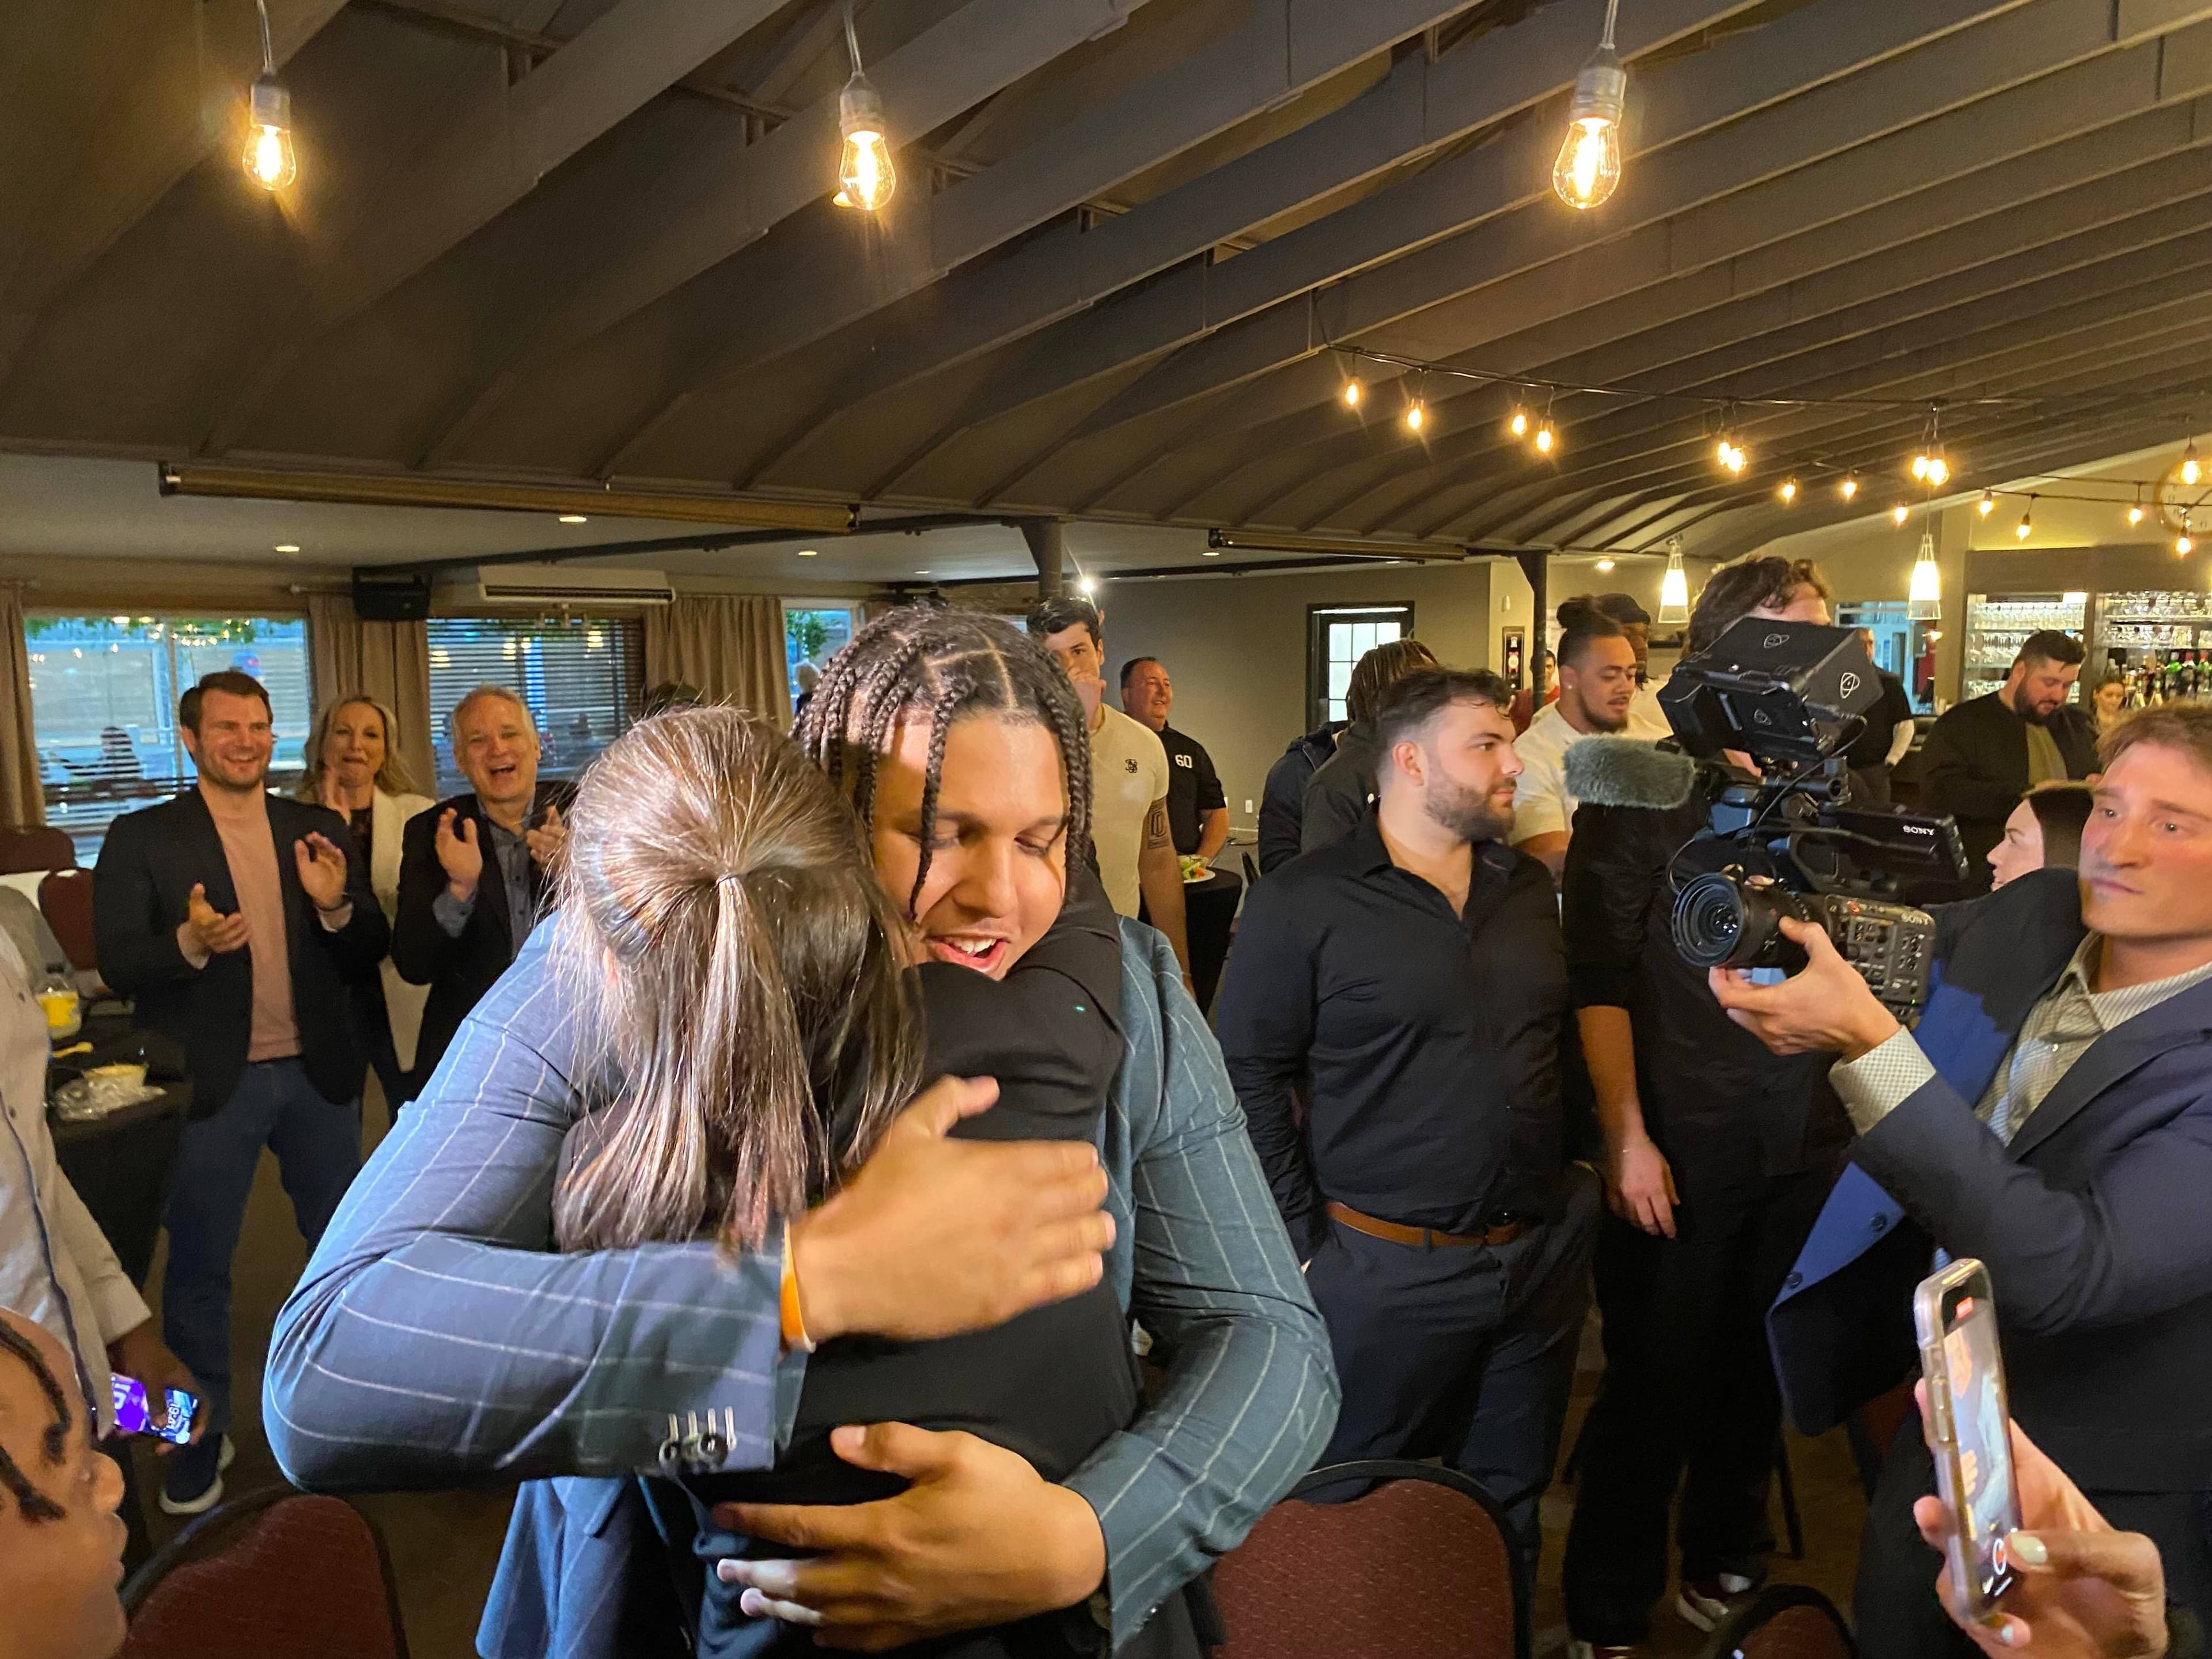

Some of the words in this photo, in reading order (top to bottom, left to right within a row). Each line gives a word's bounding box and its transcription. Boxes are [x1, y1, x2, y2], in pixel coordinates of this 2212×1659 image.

[1175, 754, 1192, 768] 60
[1903, 825, 1934, 836] SONY
[1901, 912, 1930, 925] SONY
